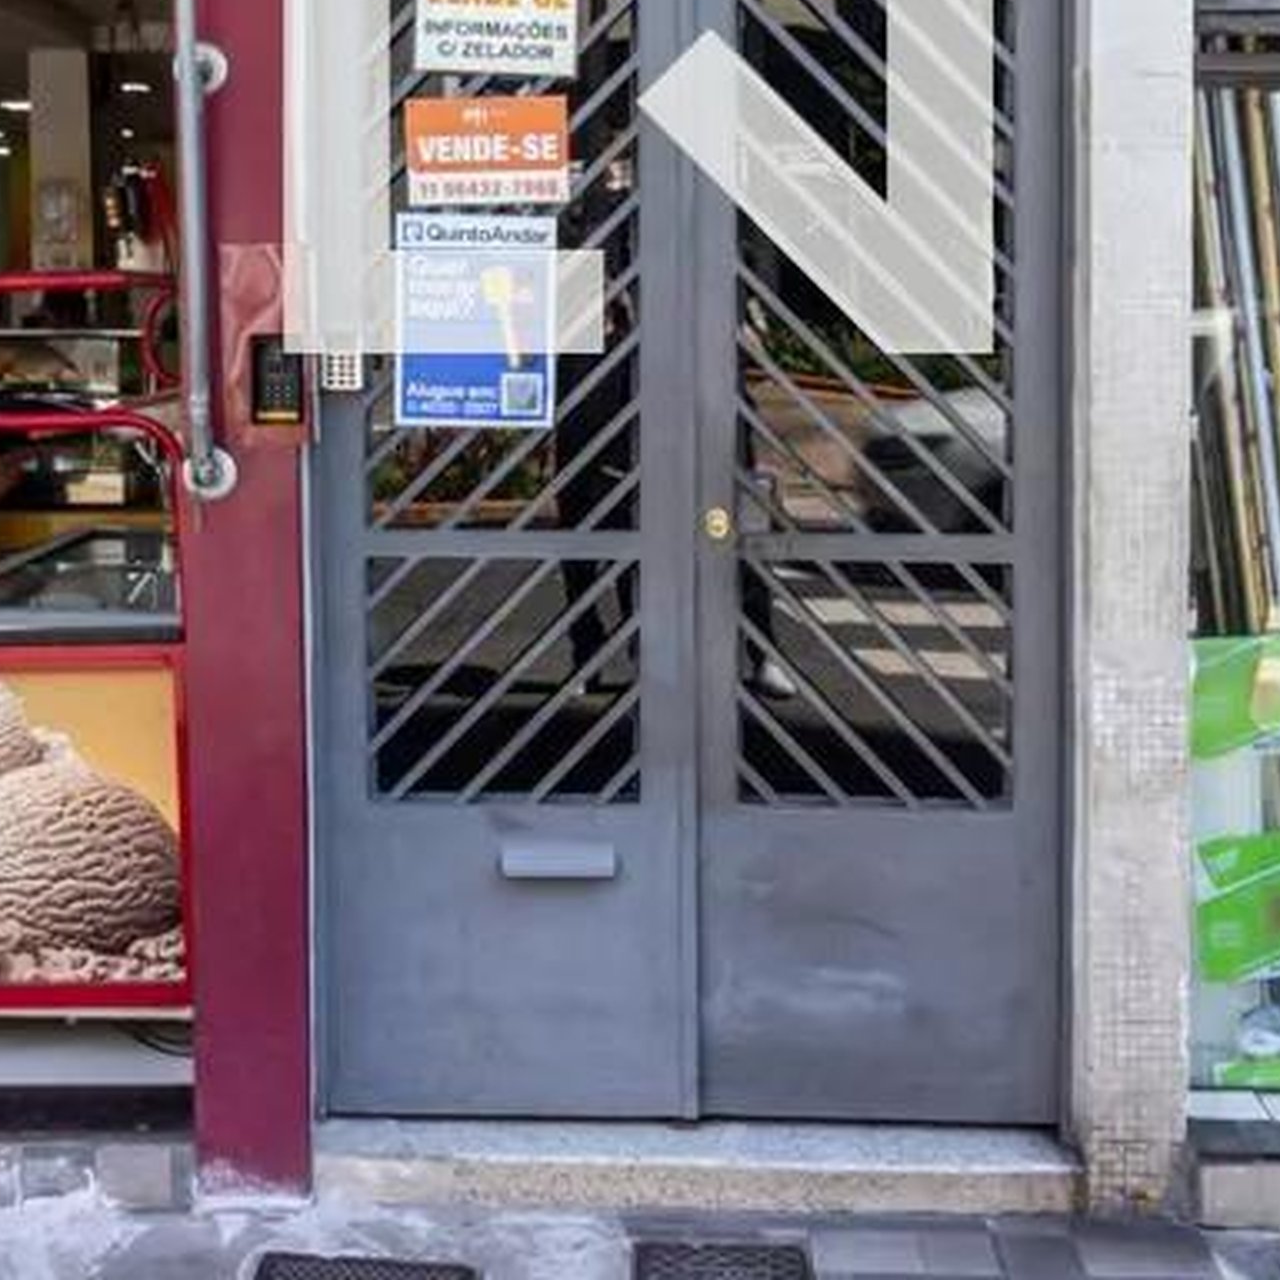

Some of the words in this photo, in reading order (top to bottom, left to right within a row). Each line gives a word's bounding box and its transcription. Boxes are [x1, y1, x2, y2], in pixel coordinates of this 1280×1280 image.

[425, 19, 568, 41] INFORMAÇÕES
[462, 40, 555, 59] ZELADOR
[417, 133, 559, 162] VENDE-SE
[426, 222, 550, 244] QuintoAndar
